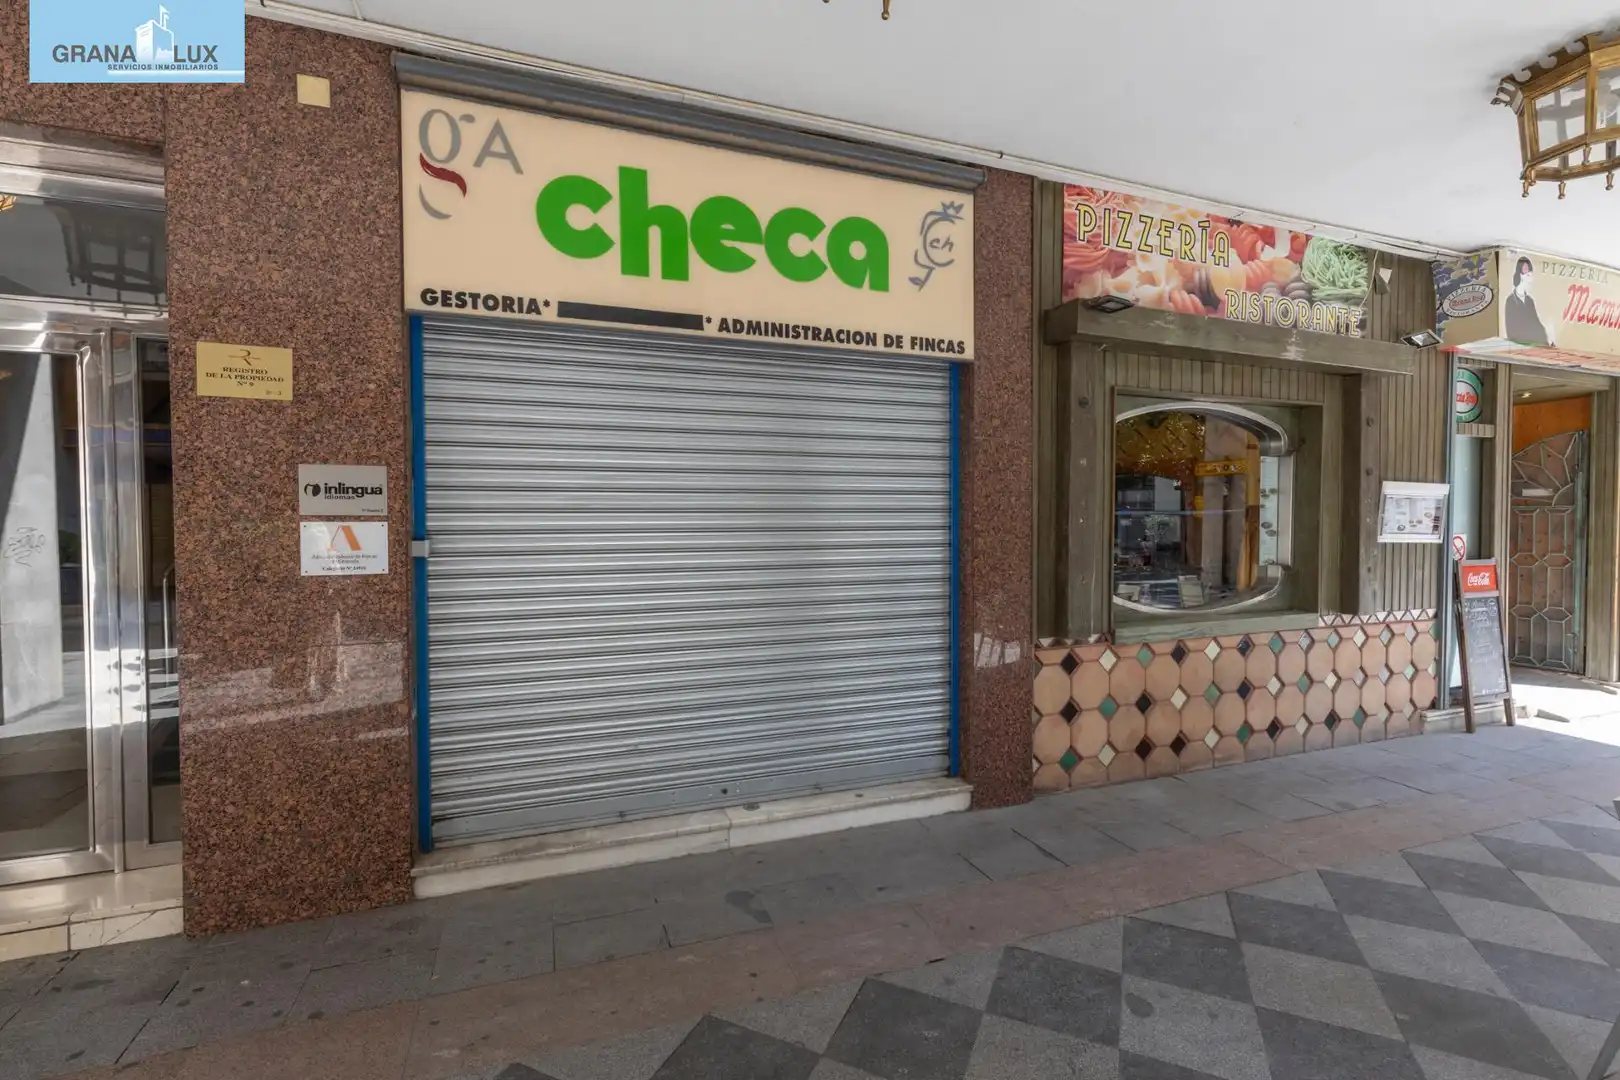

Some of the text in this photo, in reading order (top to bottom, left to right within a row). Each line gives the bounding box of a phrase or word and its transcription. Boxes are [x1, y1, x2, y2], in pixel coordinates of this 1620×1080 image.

[536, 165, 890, 293] checa
[1541, 261, 1609, 284] PIZZERIA
[1224, 288, 1362, 338] RISTORANTE
[883, 333, 904, 350] DE
[910, 336, 966, 355] FINCAS
[222, 366, 268, 375] REGISTRO
[234, 374, 284, 383] PROPIEDAD
[324, 482, 383, 498] inlingua
